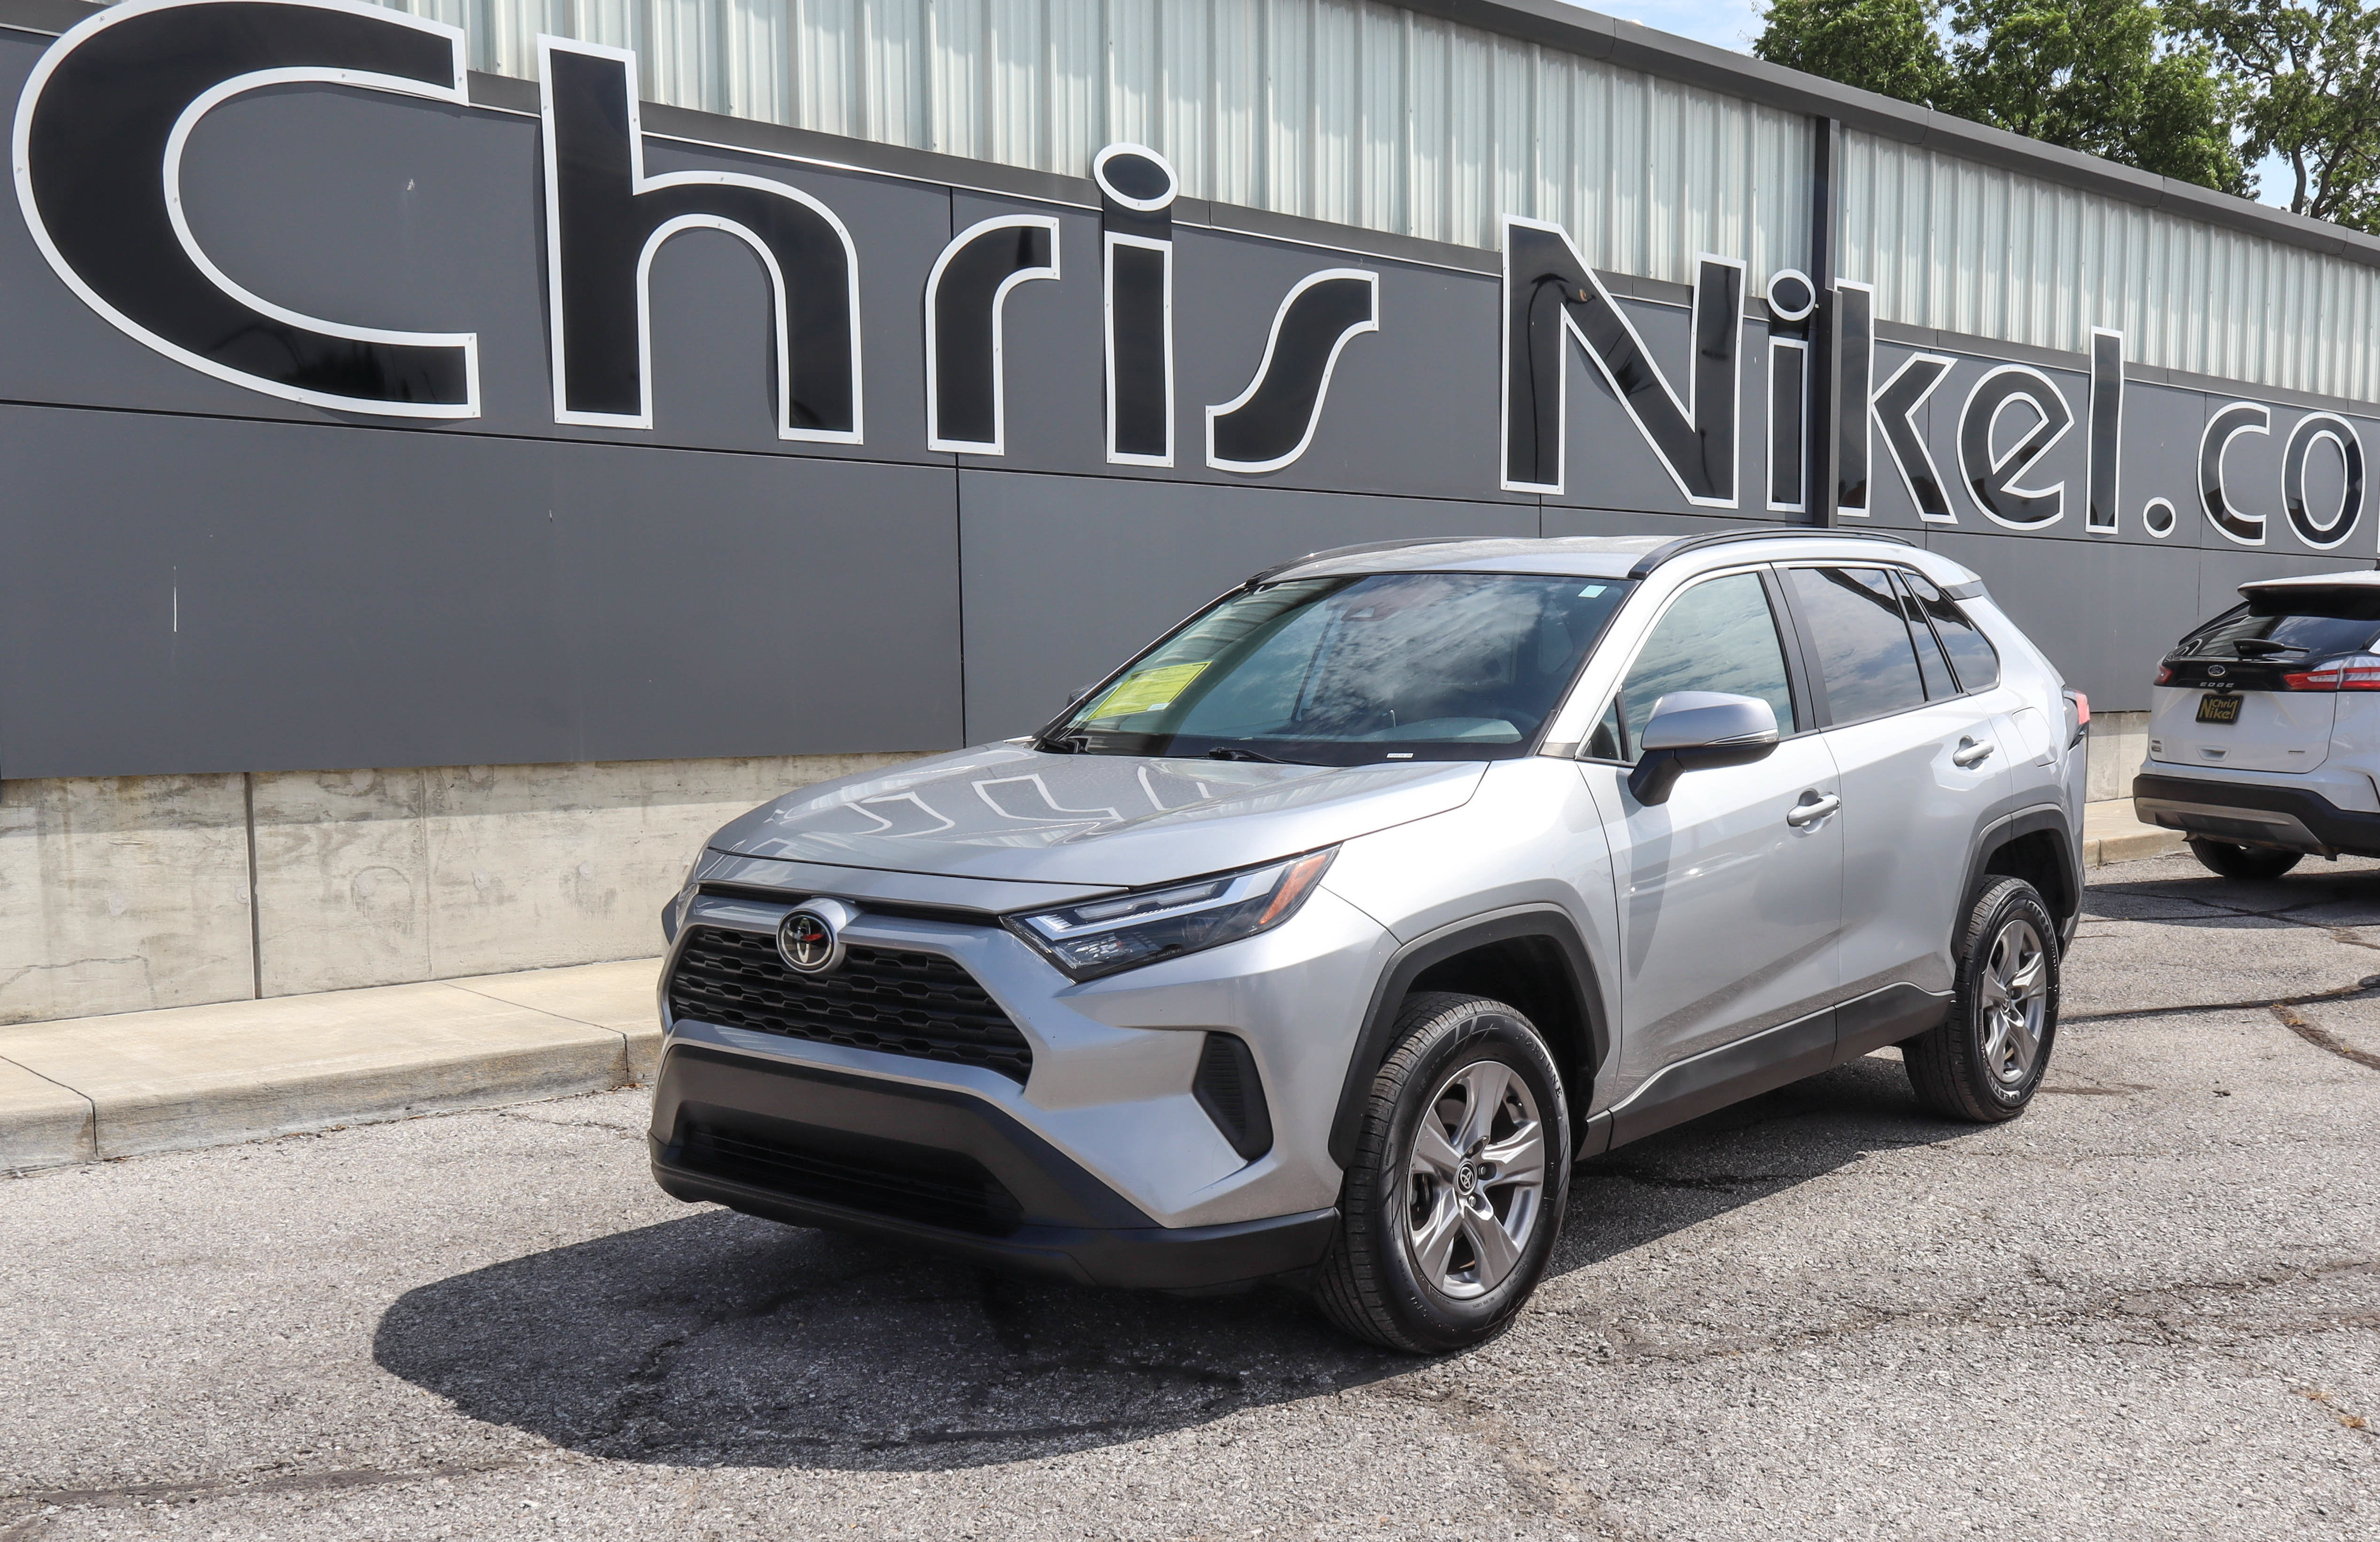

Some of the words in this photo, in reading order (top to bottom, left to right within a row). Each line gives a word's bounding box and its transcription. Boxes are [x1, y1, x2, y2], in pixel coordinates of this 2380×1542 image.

[12, 0, 1379, 473] Chris
[1500, 214, 2380, 553] Nikel.co
[2198, 698, 2239, 719] Nikel
[2213, 699, 2236, 708] Chris
[1515, 1031, 1563, 1099] FORTUNE
